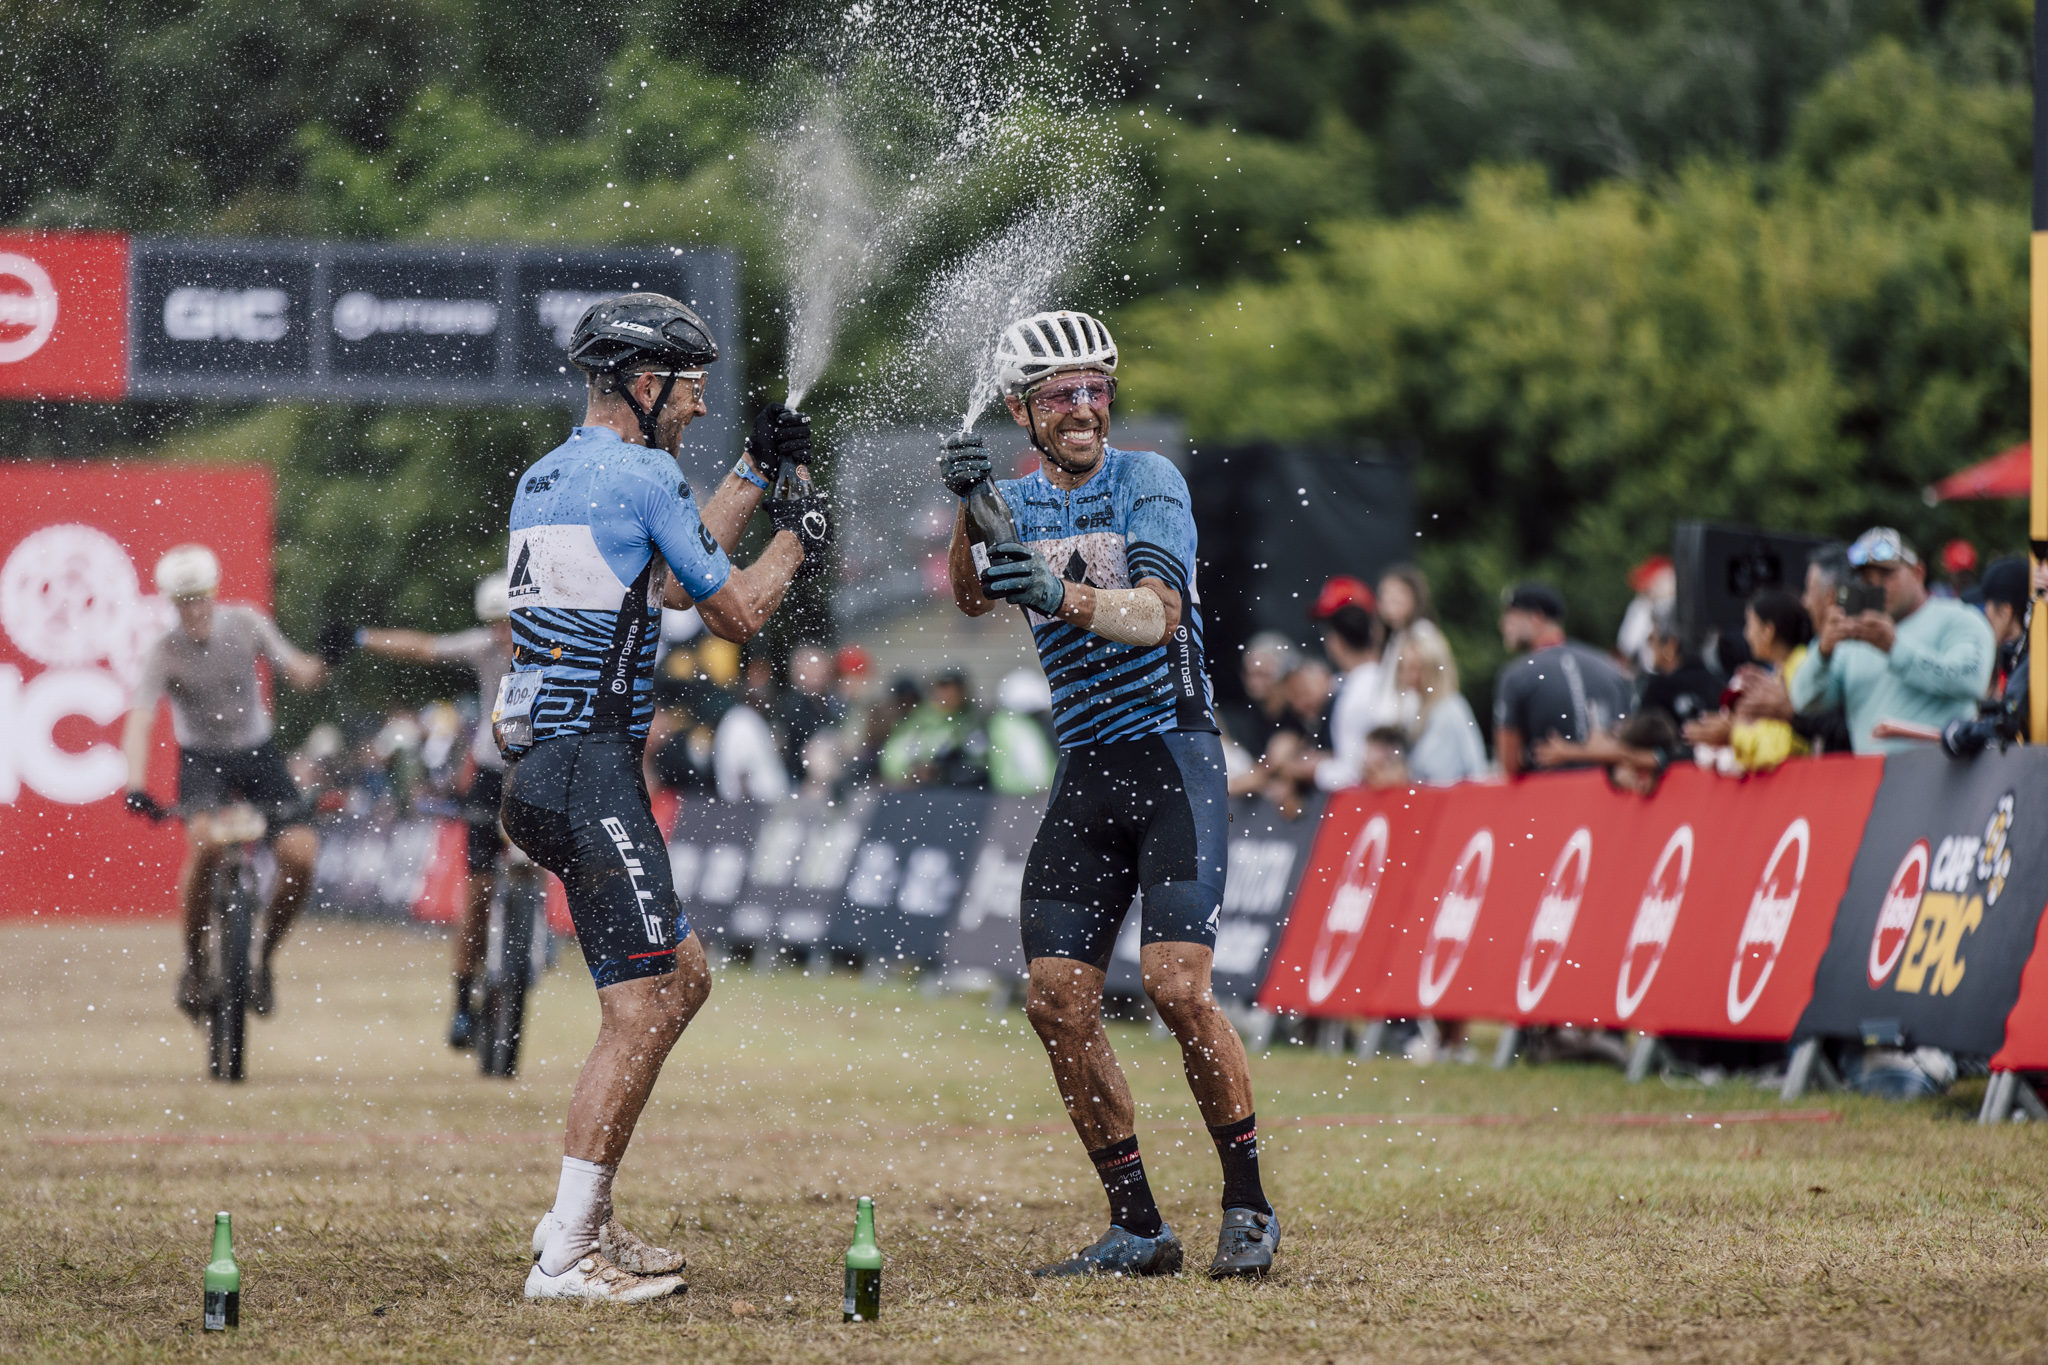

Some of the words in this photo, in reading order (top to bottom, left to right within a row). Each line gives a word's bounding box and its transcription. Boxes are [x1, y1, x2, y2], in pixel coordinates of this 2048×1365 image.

[610, 320, 654, 335] LAZER
[1145, 495, 1163, 504] NTT
[1090, 517, 1112, 529] EPIC
[1179, 643, 1190, 667] NTT
[616, 655, 629, 677] NTT
[500, 721, 518, 735] Karl
[600, 816, 664, 946] BULLS
[1894, 890, 1984, 997] EPIC
